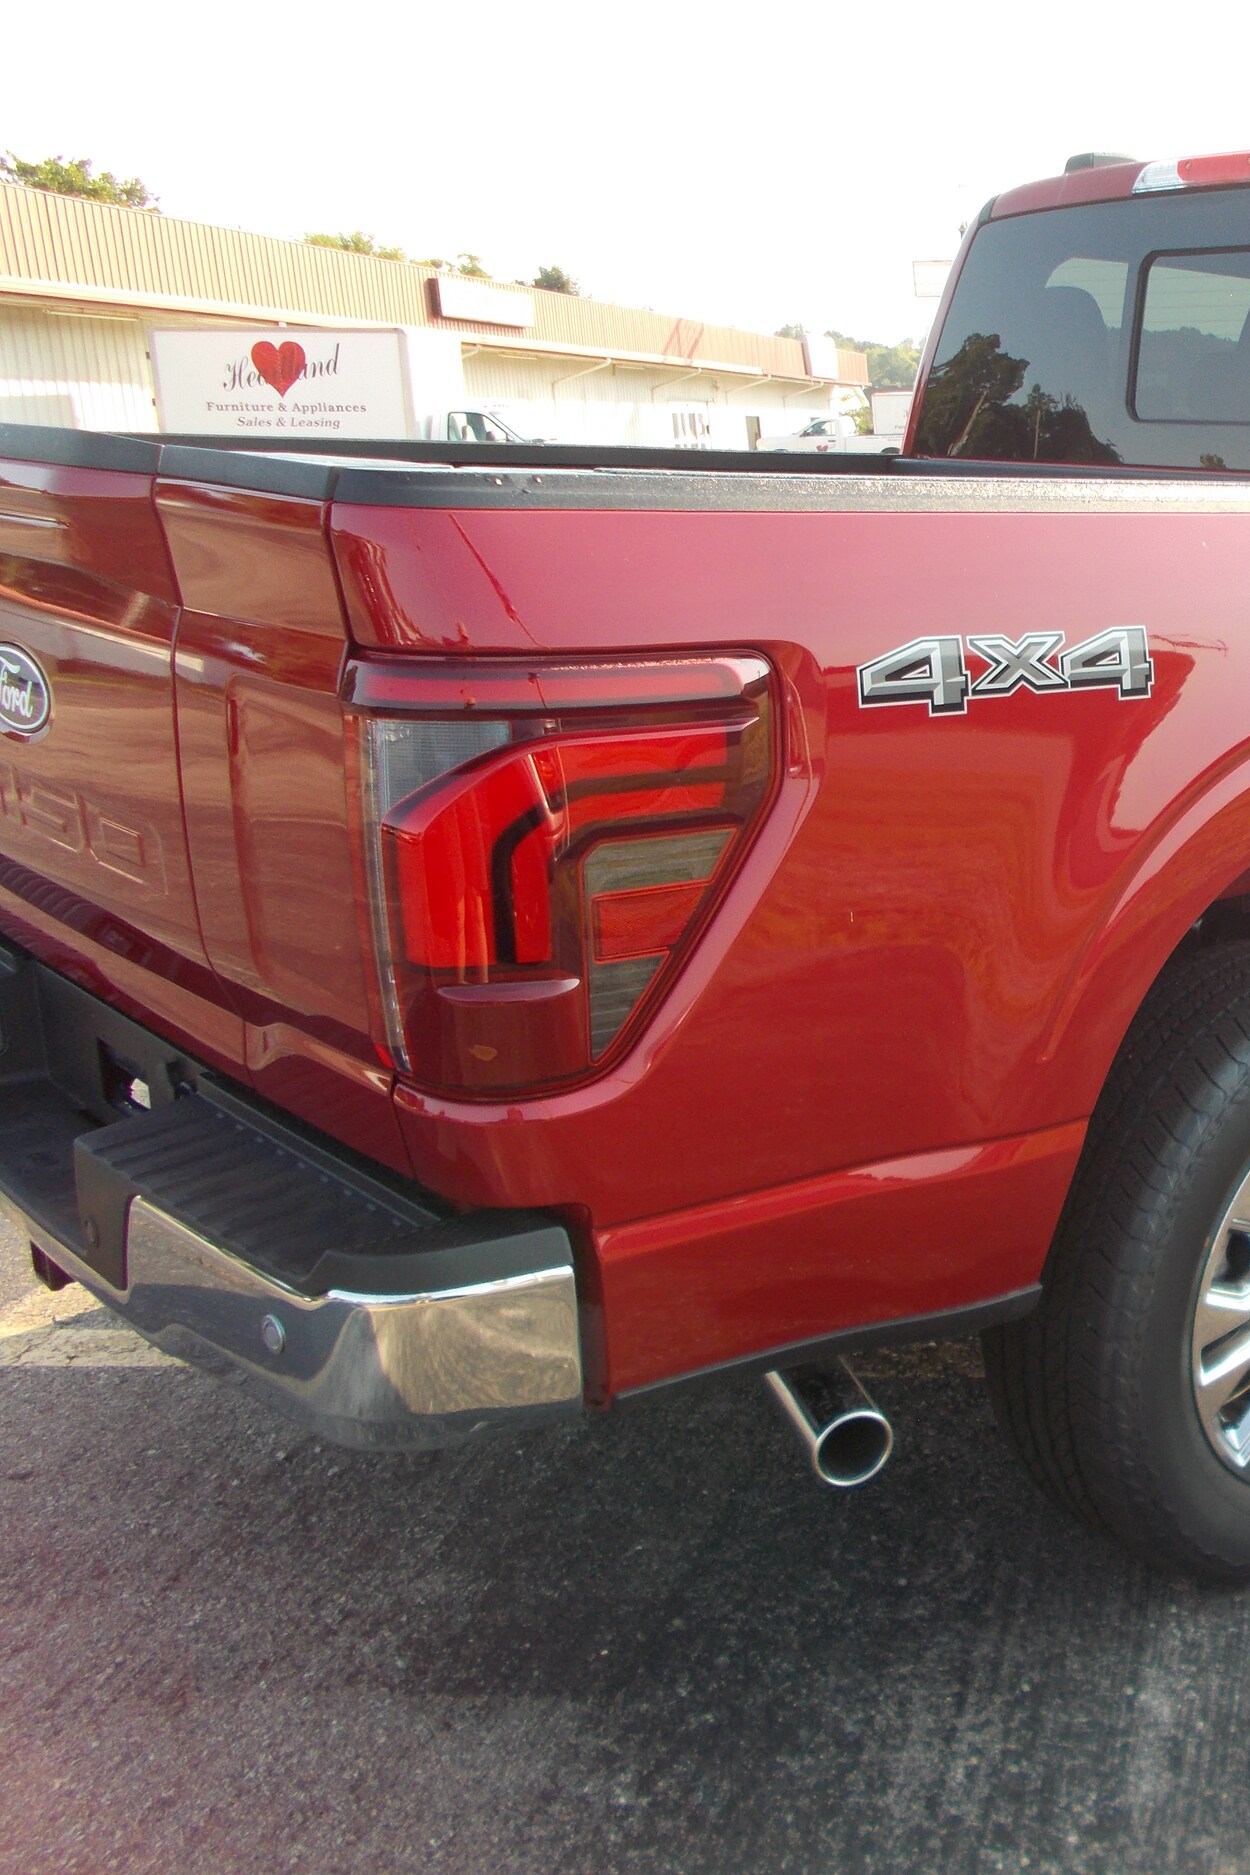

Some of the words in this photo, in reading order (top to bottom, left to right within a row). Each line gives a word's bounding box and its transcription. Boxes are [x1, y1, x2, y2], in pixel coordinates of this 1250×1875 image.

[223, 343, 340, 392] Heaand
[207, 401, 274, 412] Furniture
[278, 402, 287, 412] &
[292, 402, 367, 414] Appliances
[236, 416, 272, 427] Sales
[276, 417, 286, 427] &
[290, 417, 340, 429] Leasing
